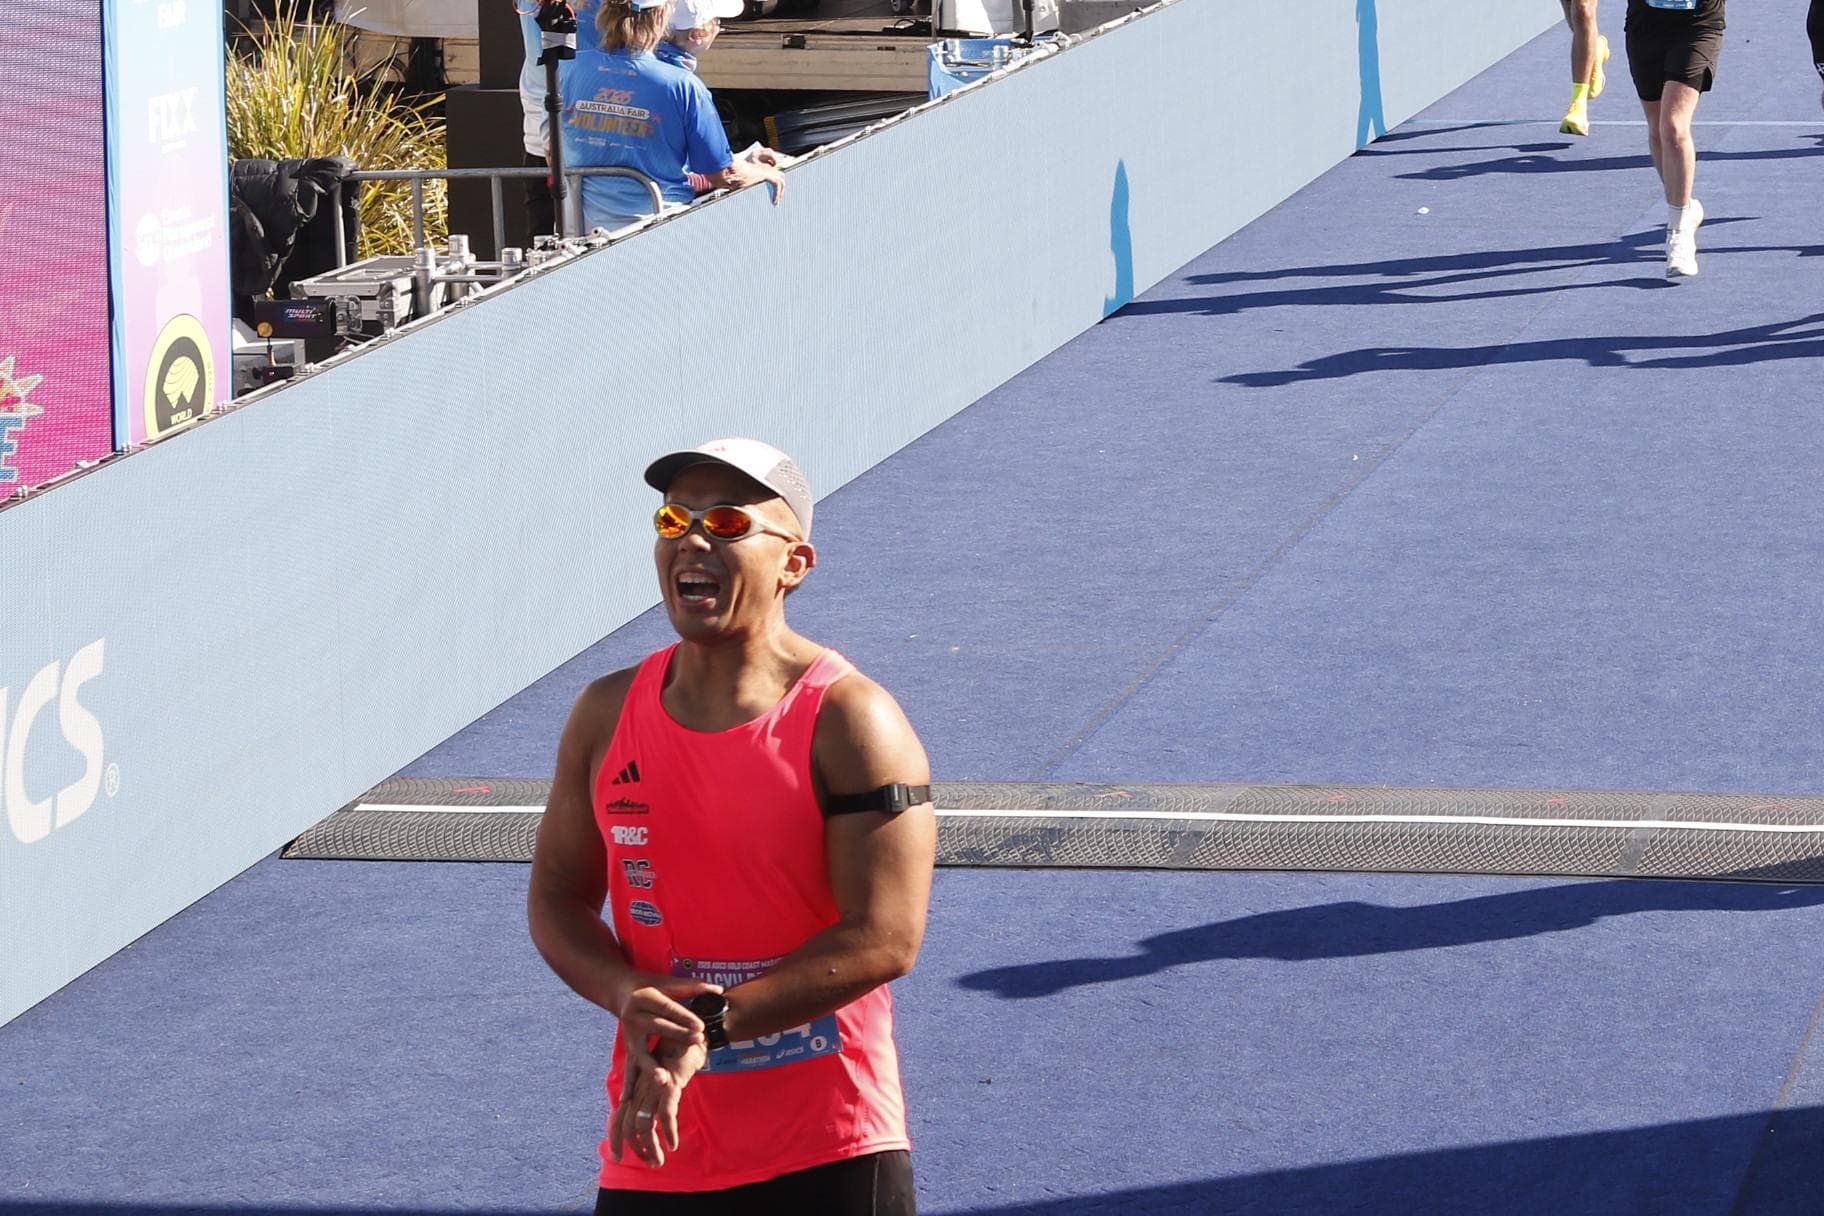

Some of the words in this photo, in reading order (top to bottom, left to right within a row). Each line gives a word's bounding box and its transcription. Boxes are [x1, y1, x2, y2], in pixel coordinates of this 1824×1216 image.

[579, 102, 625, 115] AUSTRALIA
[627, 108, 646, 118] FAIR
[169, 408, 193, 425] WORLD
